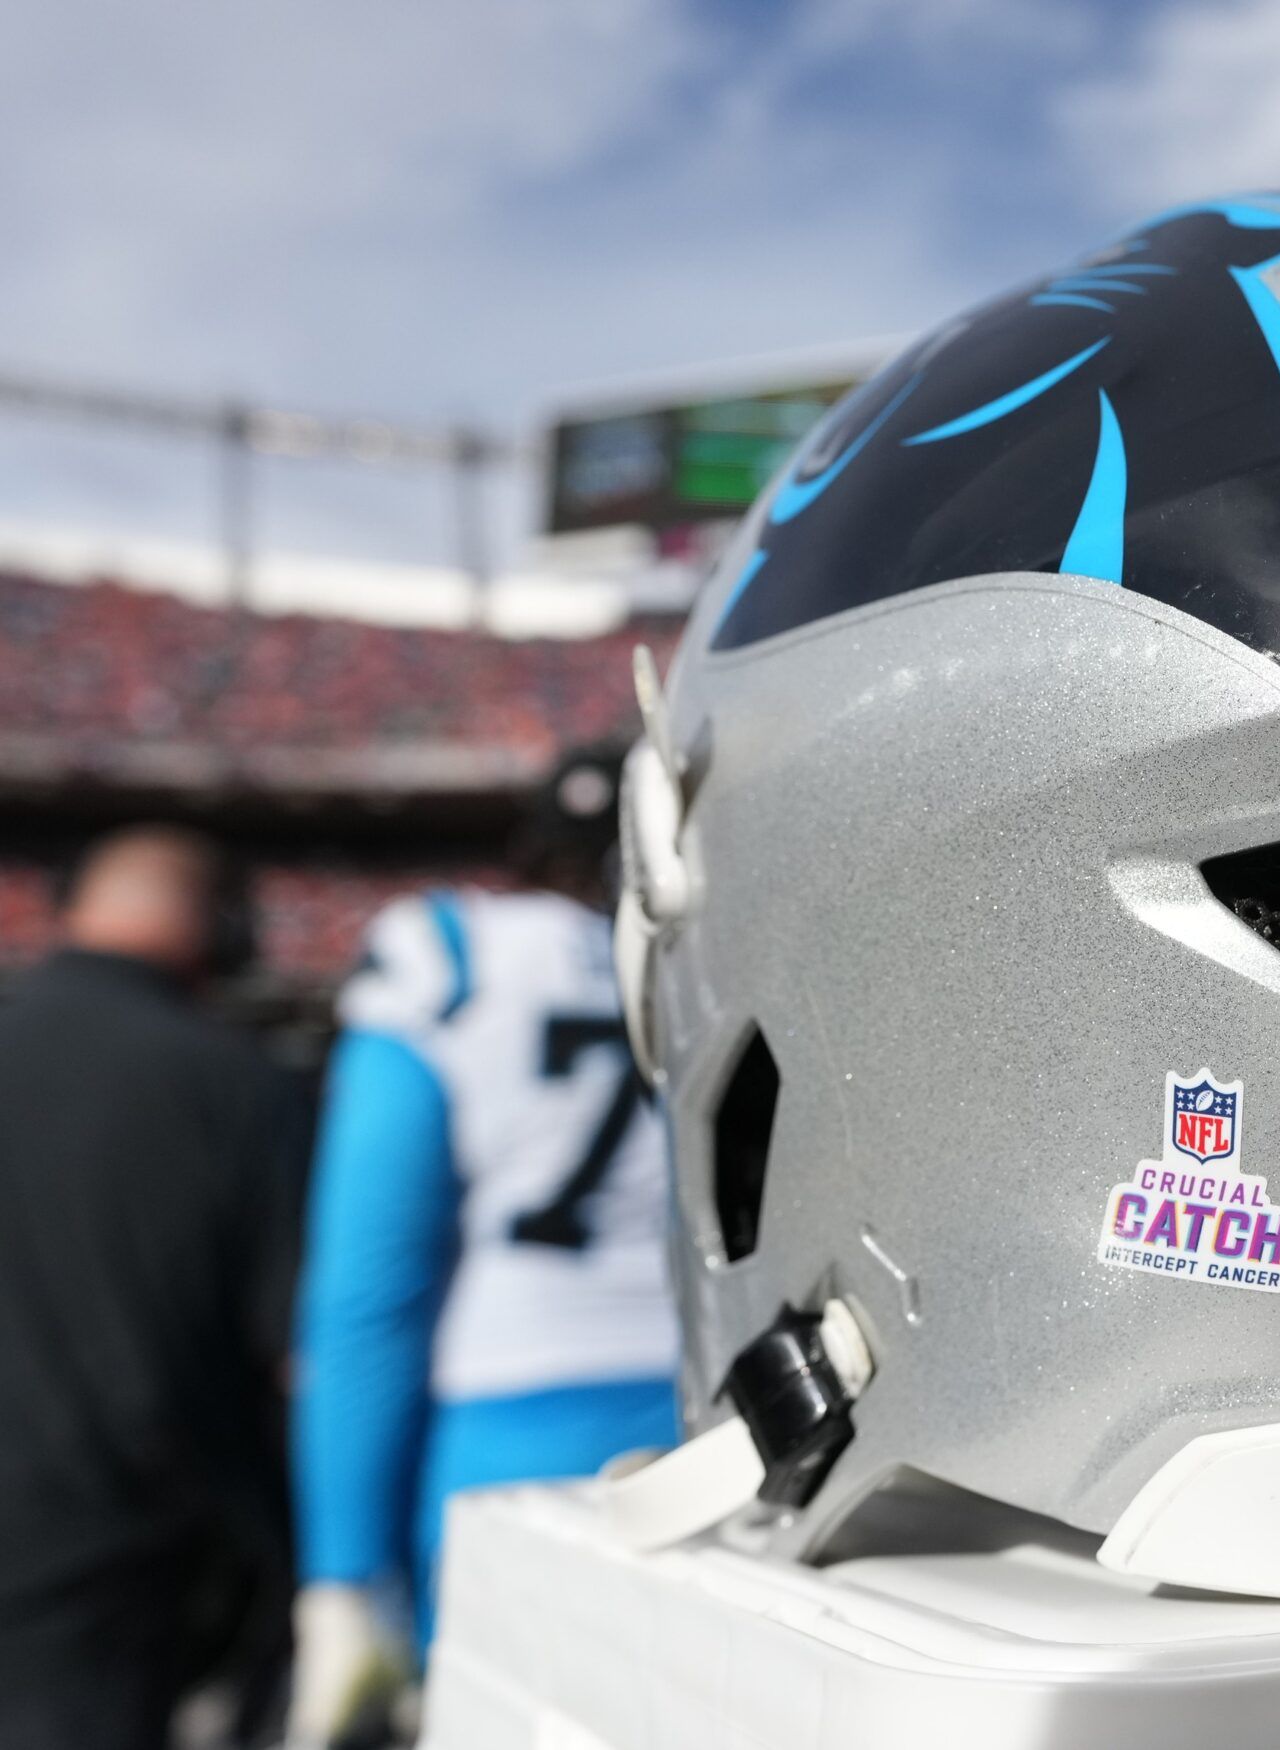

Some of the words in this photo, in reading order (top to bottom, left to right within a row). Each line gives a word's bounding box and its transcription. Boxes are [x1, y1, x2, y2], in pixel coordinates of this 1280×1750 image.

[1178, 1113, 1229, 1155] NFL
[1141, 1169, 1264, 1207] CRUCIAL
[1105, 1244, 1198, 1275] INTERCEPT
[1207, 1264, 1280, 1288] CANCER
